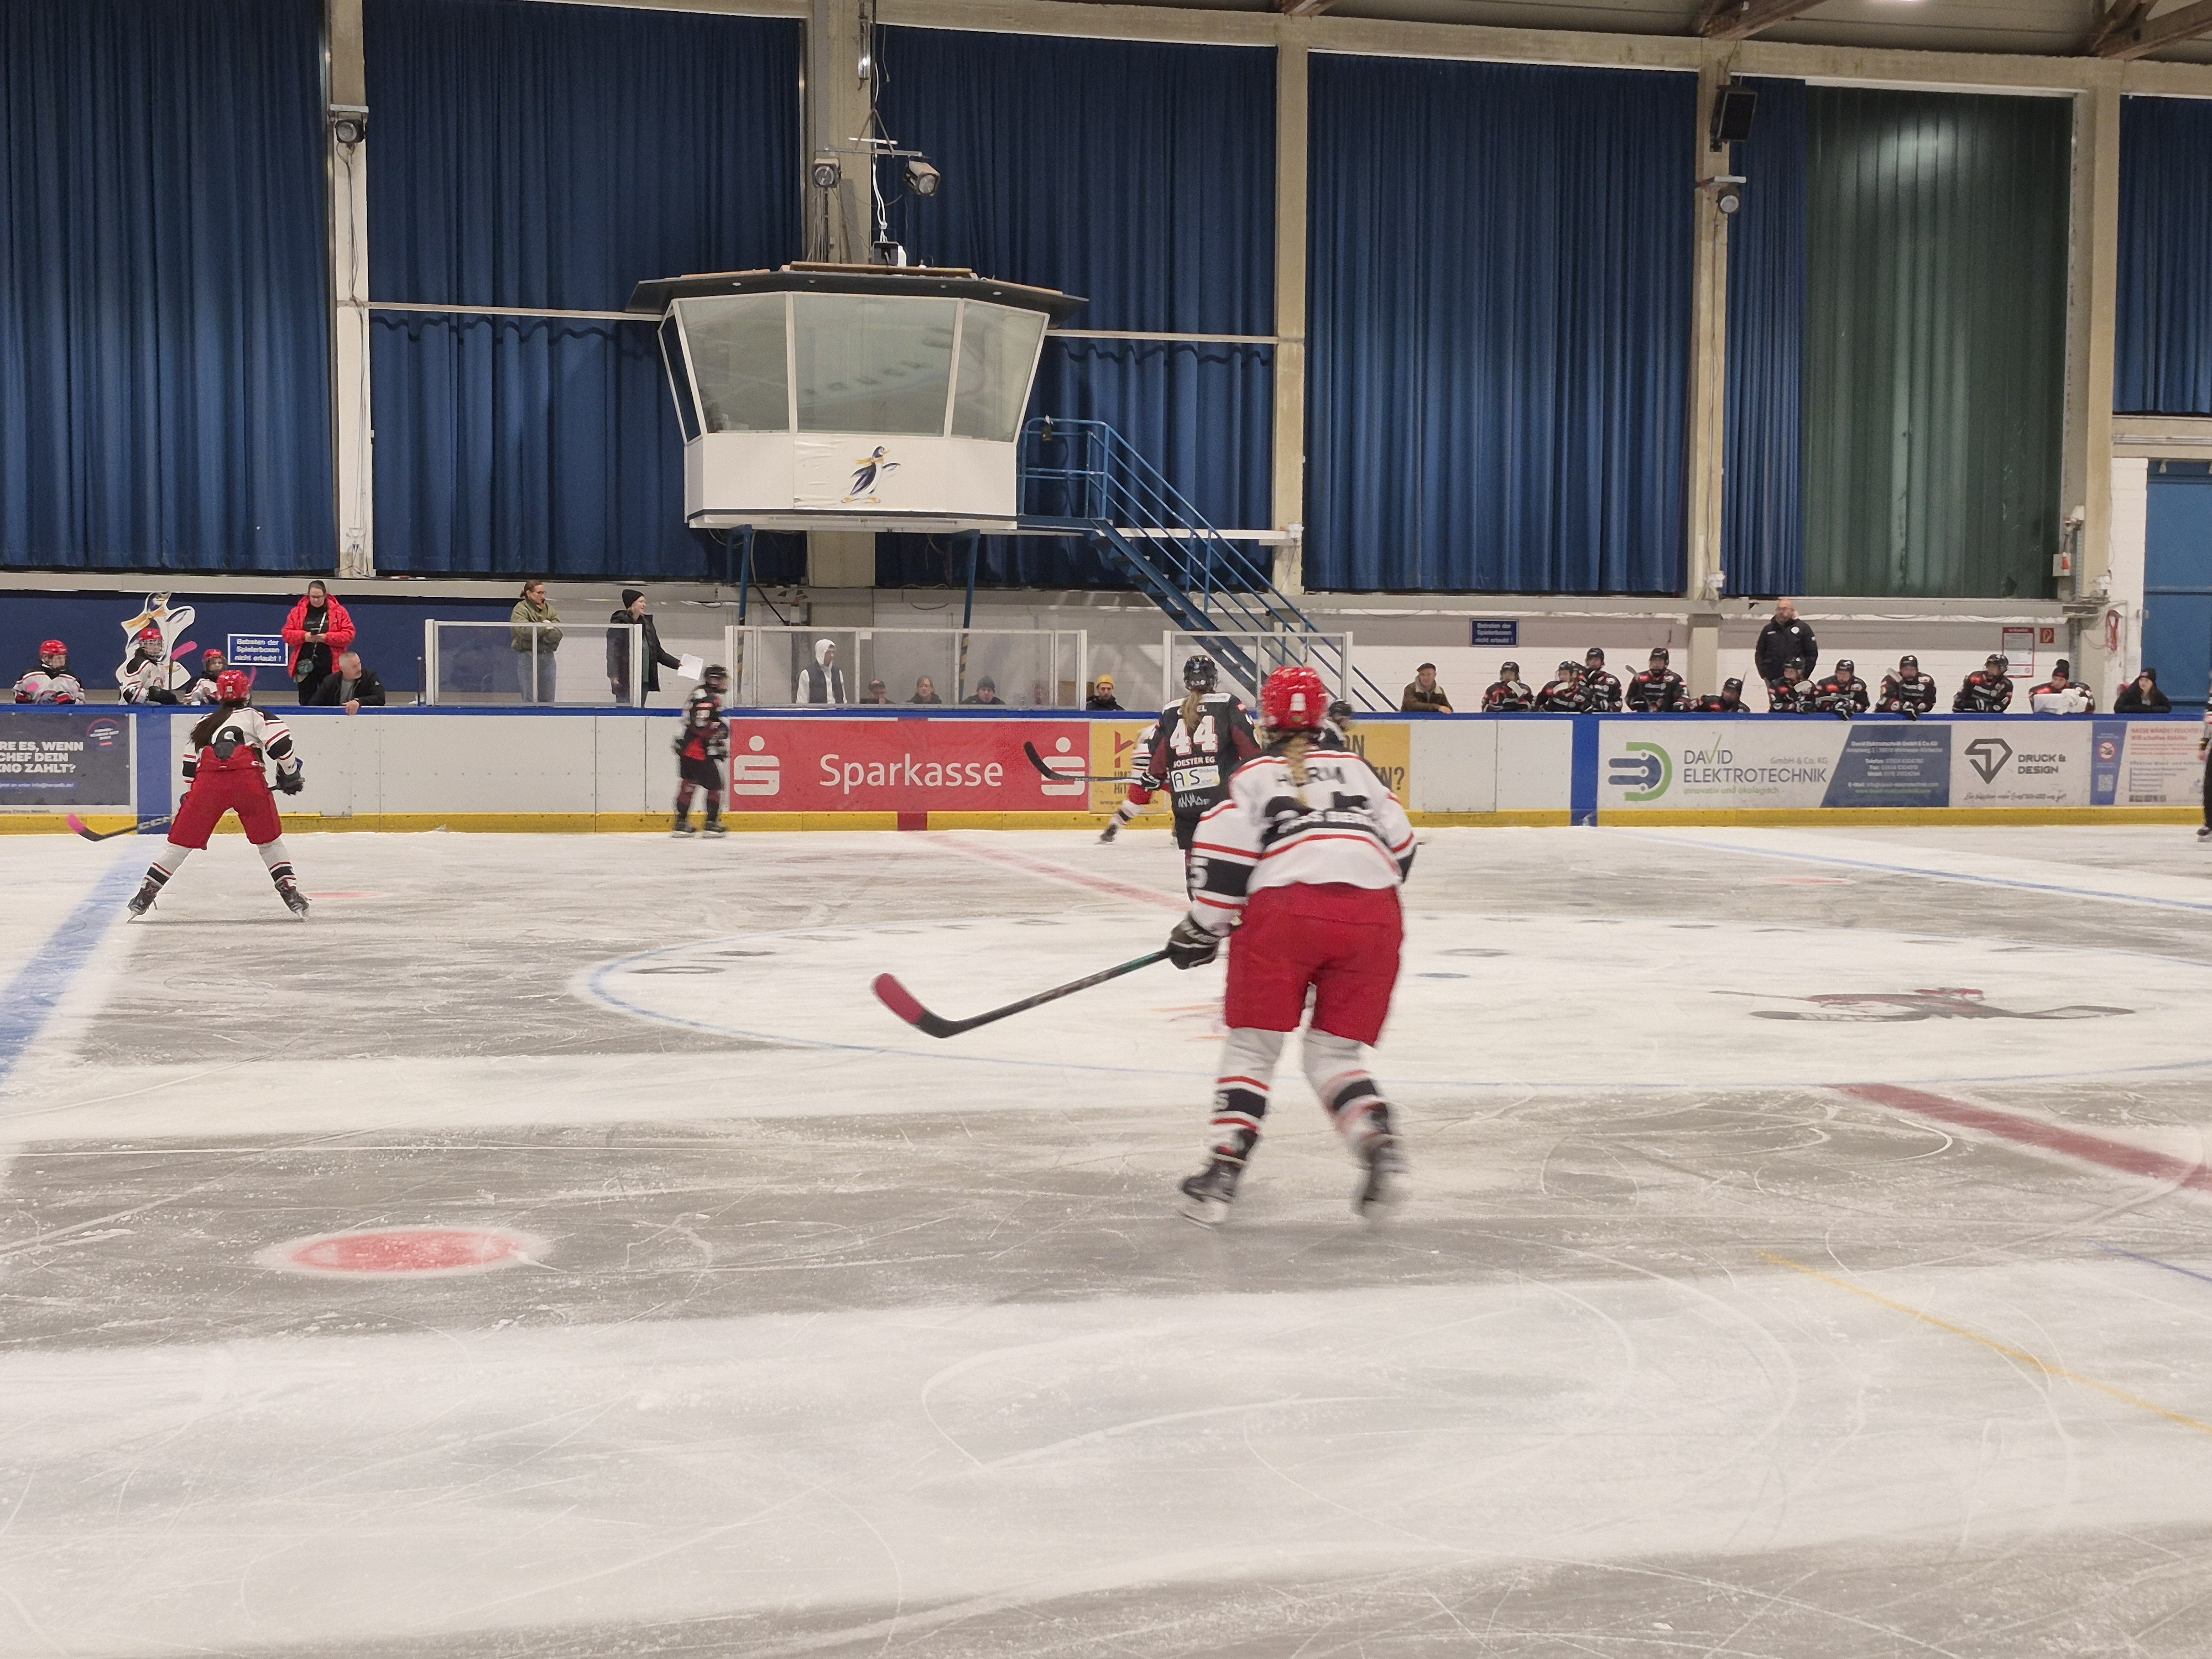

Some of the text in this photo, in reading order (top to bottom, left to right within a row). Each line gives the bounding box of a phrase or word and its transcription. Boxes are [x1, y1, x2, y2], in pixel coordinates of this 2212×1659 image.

[1170, 715, 1218, 756] 44
[19, 741, 39, 752] ES,
[41, 741, 84, 751] WENN
[1684, 734, 1733, 764] DAVID
[0, 752, 69, 761] CHEF DEIN
[2018, 754, 2066, 763] DRUCK &
[0, 763, 76, 773] NG ZAHLT?
[820, 753, 1003, 794] Sparkasse
[2018, 765, 2059, 774] DESIGN
[1683, 768, 1827, 782] ELEKTROTECHNIK
